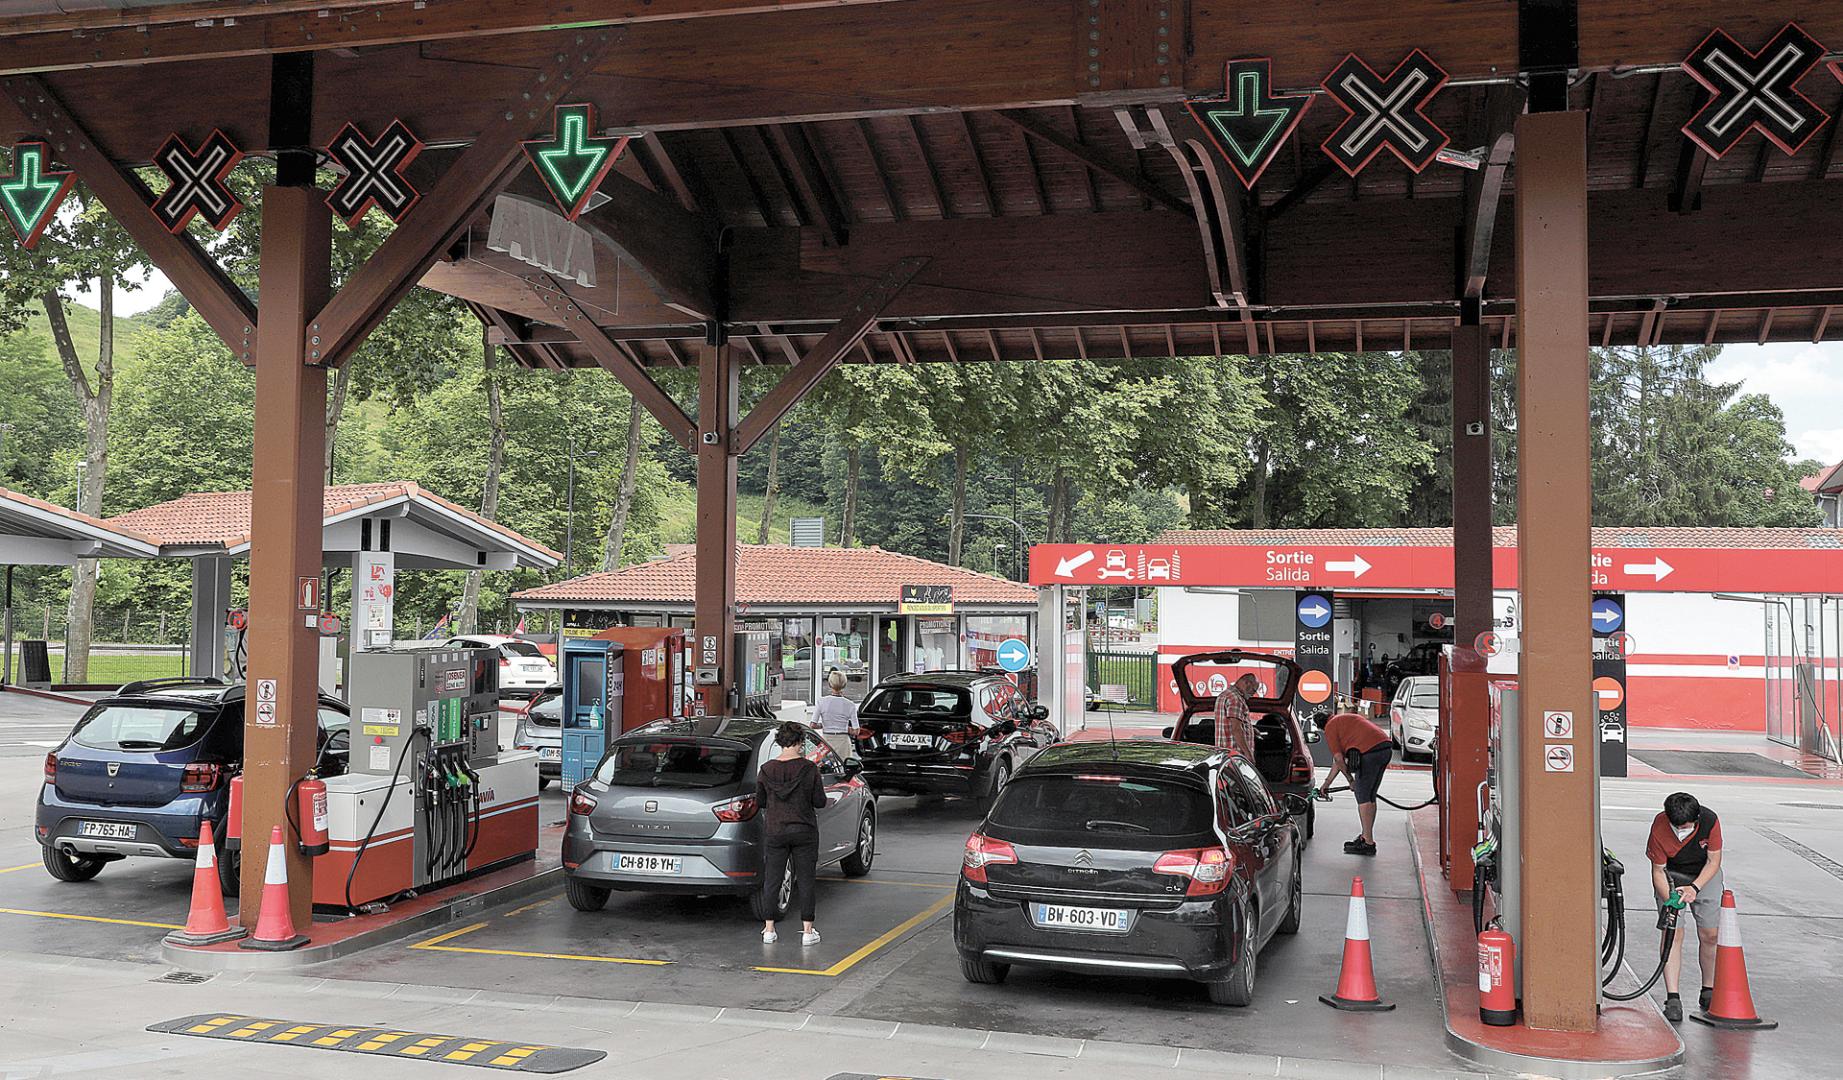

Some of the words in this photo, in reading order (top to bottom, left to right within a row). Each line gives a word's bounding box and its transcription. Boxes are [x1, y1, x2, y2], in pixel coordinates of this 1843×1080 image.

[1266, 551, 1314, 564] Sortie
[1591, 553, 1612, 567] tie
[1266, 567, 1310, 581] Salida
[1299, 632, 1330, 641] Sortie
[1300, 645, 1329, 655] Salida
[606, 652, 614, 711] Autofuel
[891, 734, 927, 744] CF-404-XK
[83, 821, 130, 838] FP-765-HA
[621, 856, 674, 870] CH-818-YH
[1048, 907, 1117, 926] BW-603-VD
